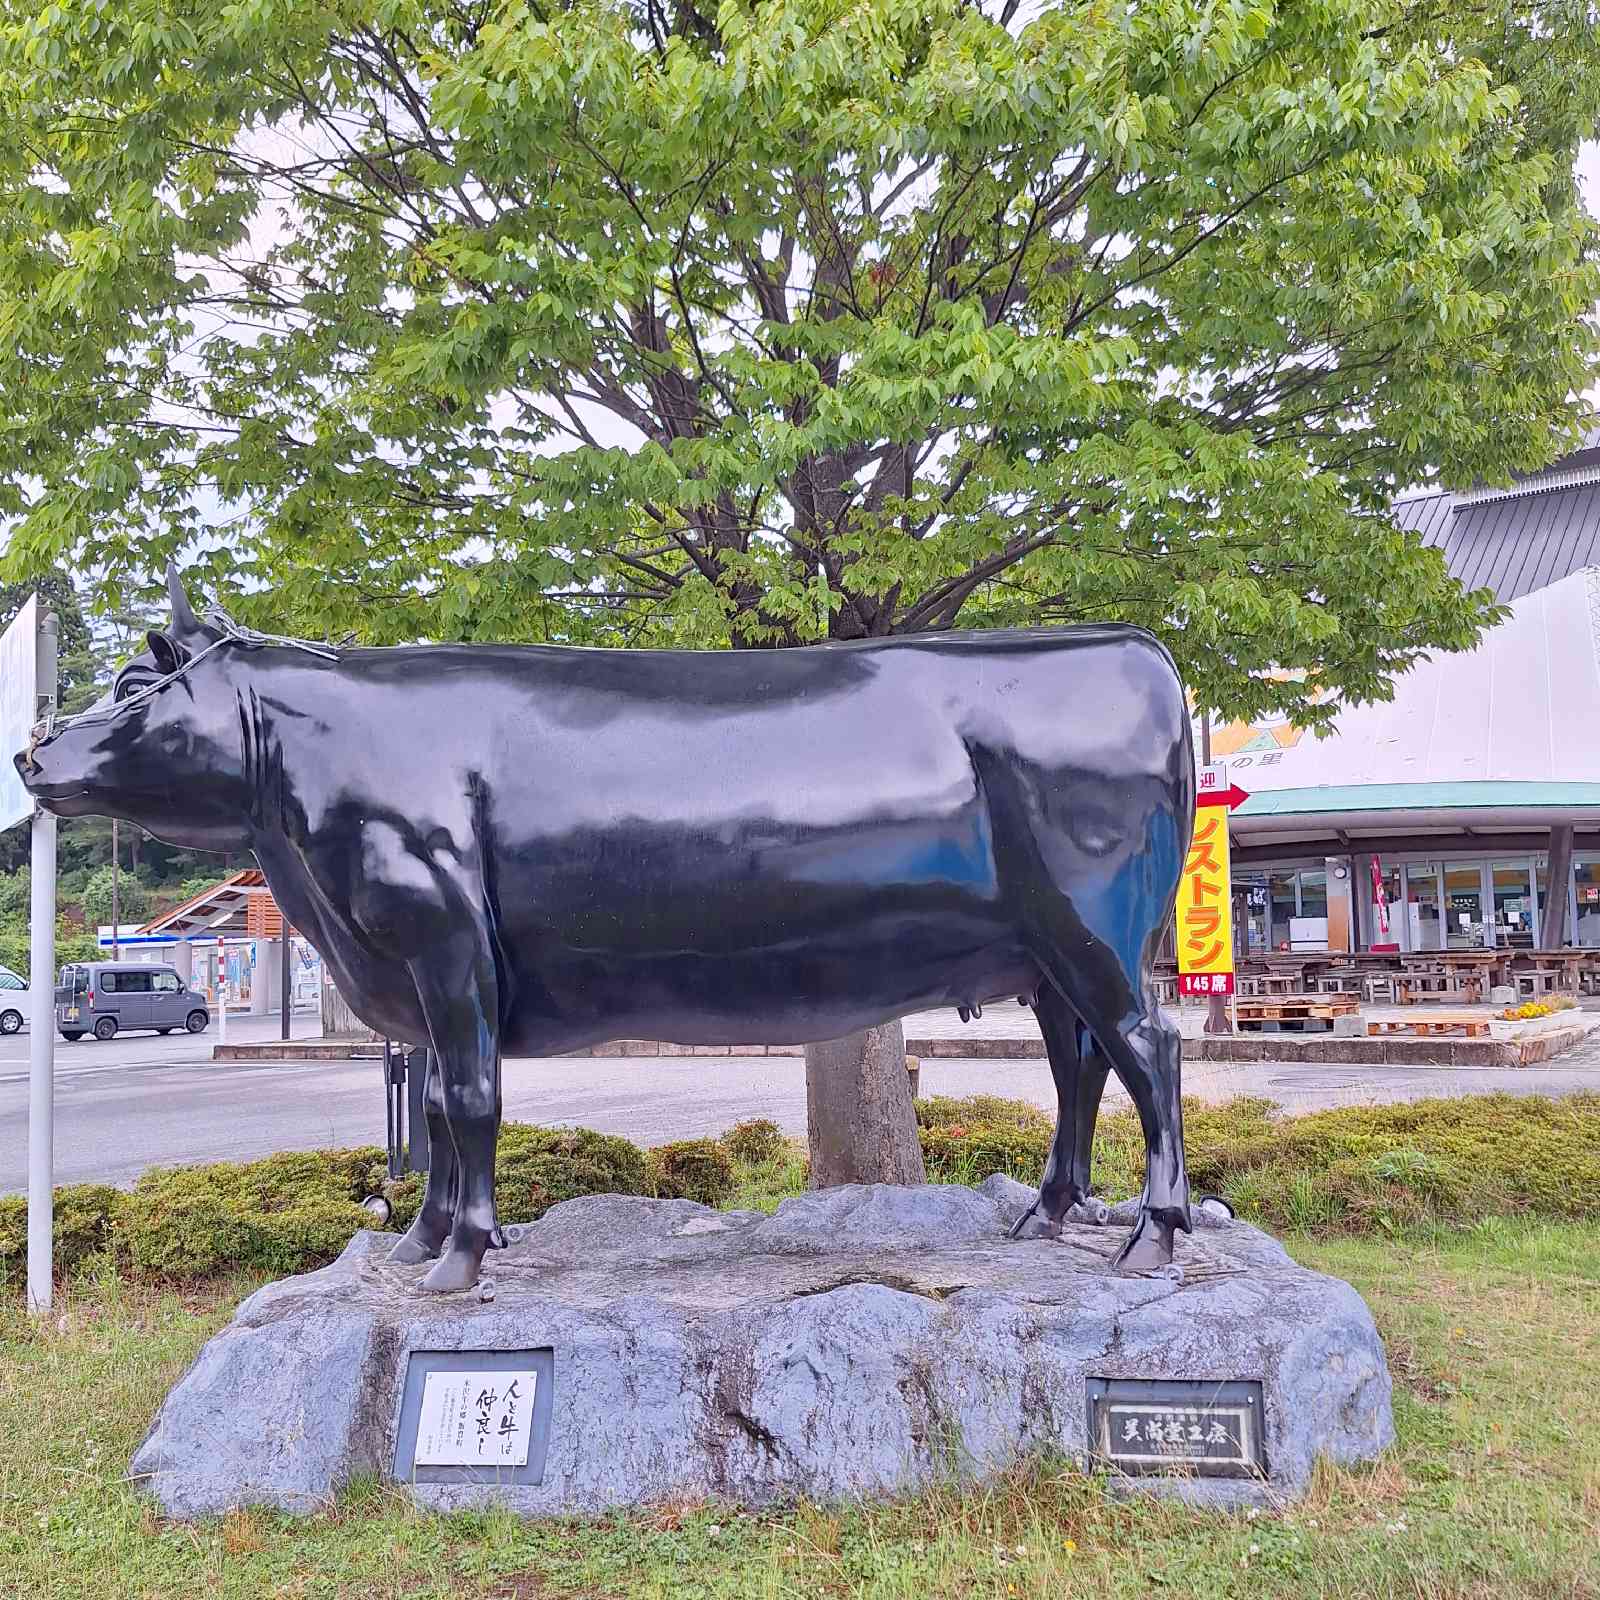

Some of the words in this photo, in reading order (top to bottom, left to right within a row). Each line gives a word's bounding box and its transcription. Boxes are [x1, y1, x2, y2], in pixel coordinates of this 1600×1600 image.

[1212, 752, 1284, 769] の里
[1200, 772, 1216, 789] 迎
[1185, 975, 1227, 993] 145席
[475, 1387, 498, 1456] 仲良し
[498, 1378, 523, 1456] 人と牛は
